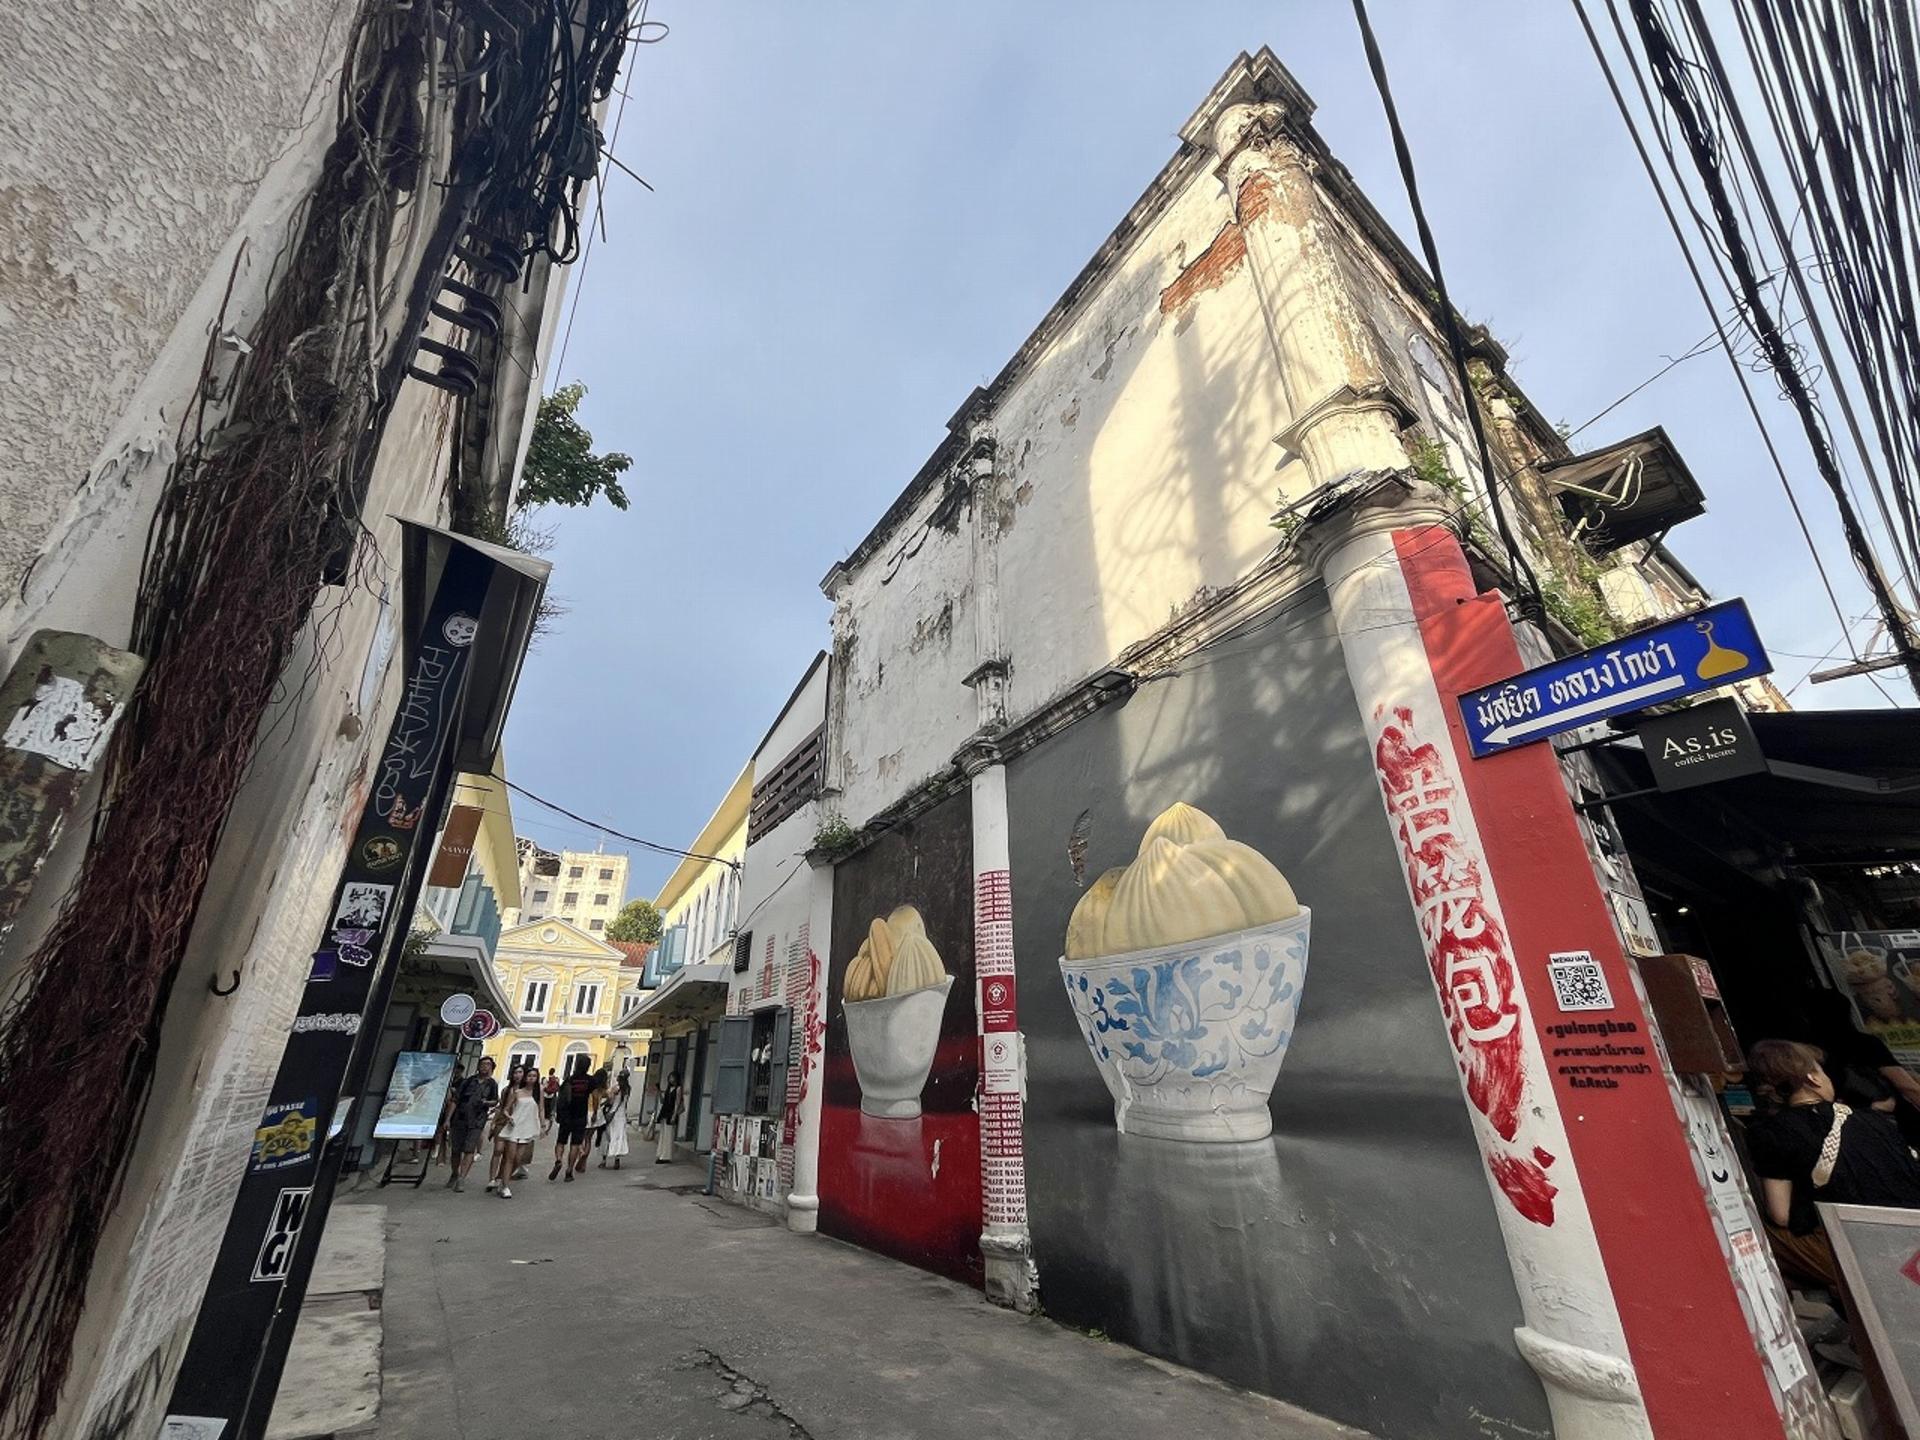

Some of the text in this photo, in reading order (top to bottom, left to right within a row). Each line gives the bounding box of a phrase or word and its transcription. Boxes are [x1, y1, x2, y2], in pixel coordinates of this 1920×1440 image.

[1662, 726, 1738, 760] As.is
[1674, 746, 1736, 768] coffee beans
